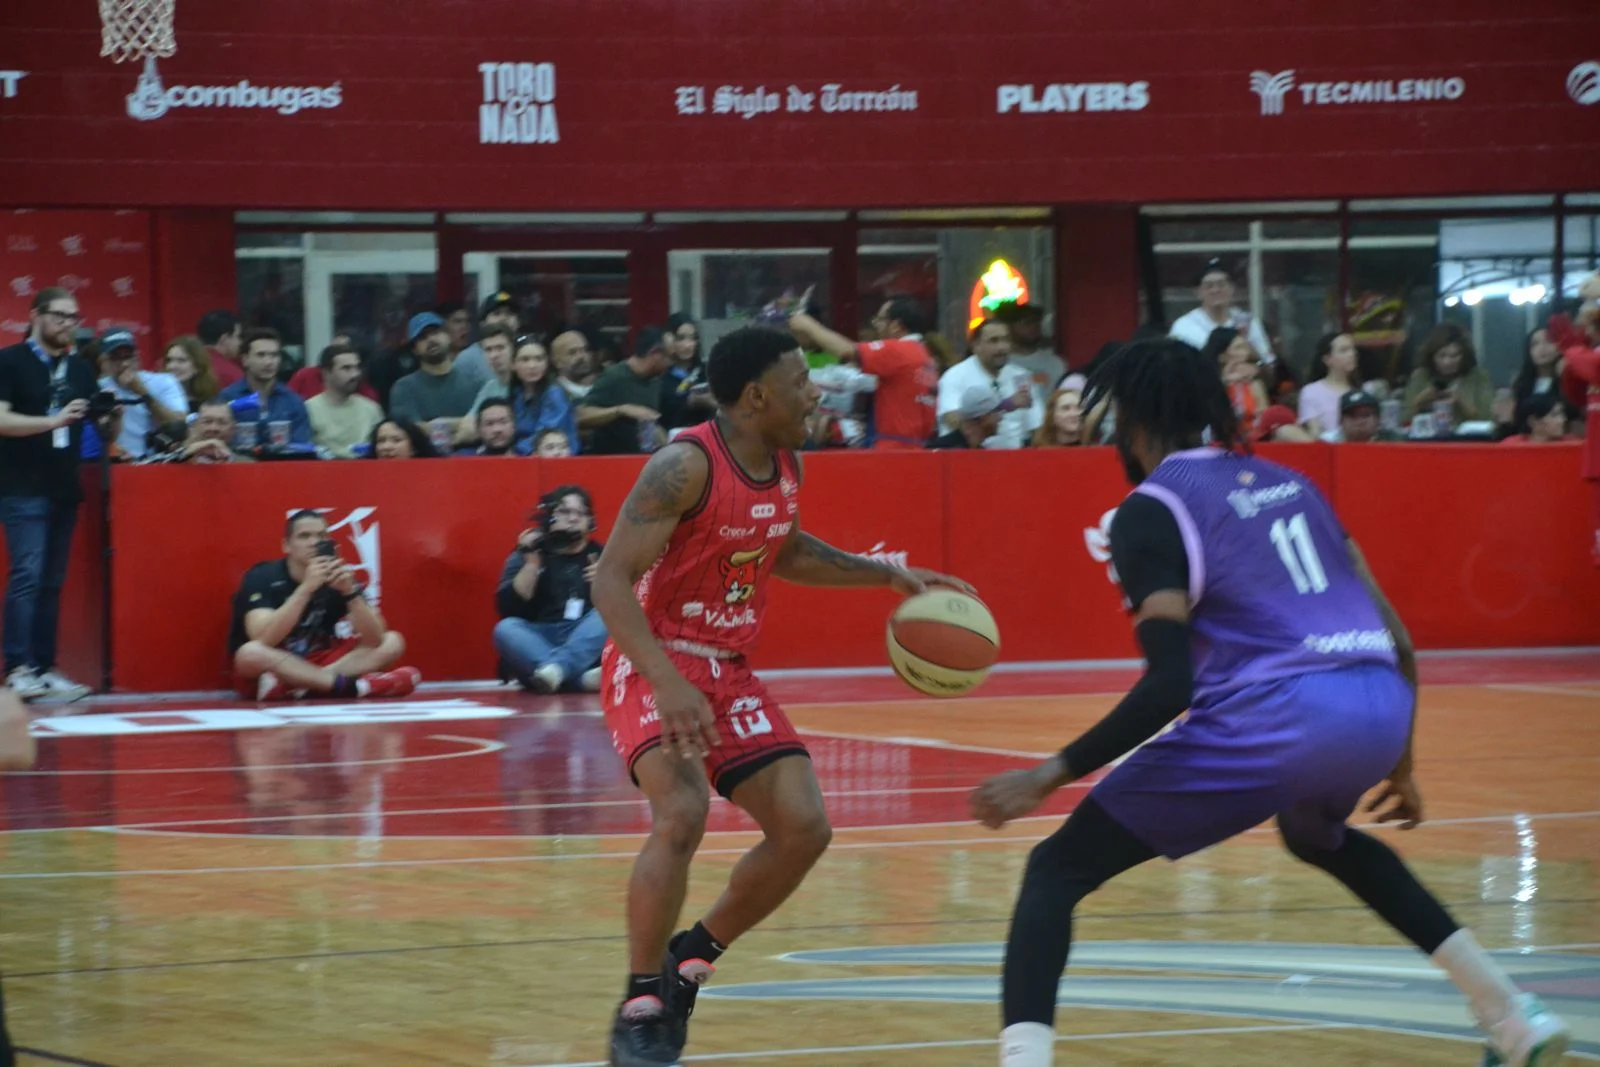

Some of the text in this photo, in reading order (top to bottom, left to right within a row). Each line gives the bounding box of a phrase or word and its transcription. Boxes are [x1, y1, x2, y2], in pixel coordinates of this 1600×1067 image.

[166, 80, 342, 114] combugas
[479, 62, 556, 102] TORO
[997, 81, 1149, 112] PLAYERS
[1300, 77, 1466, 104] TECMILENIO
[675, 83, 918, 119] El Siglo de Torreón
[479, 103, 560, 143] NADA
[1270, 512, 1329, 594] 11
